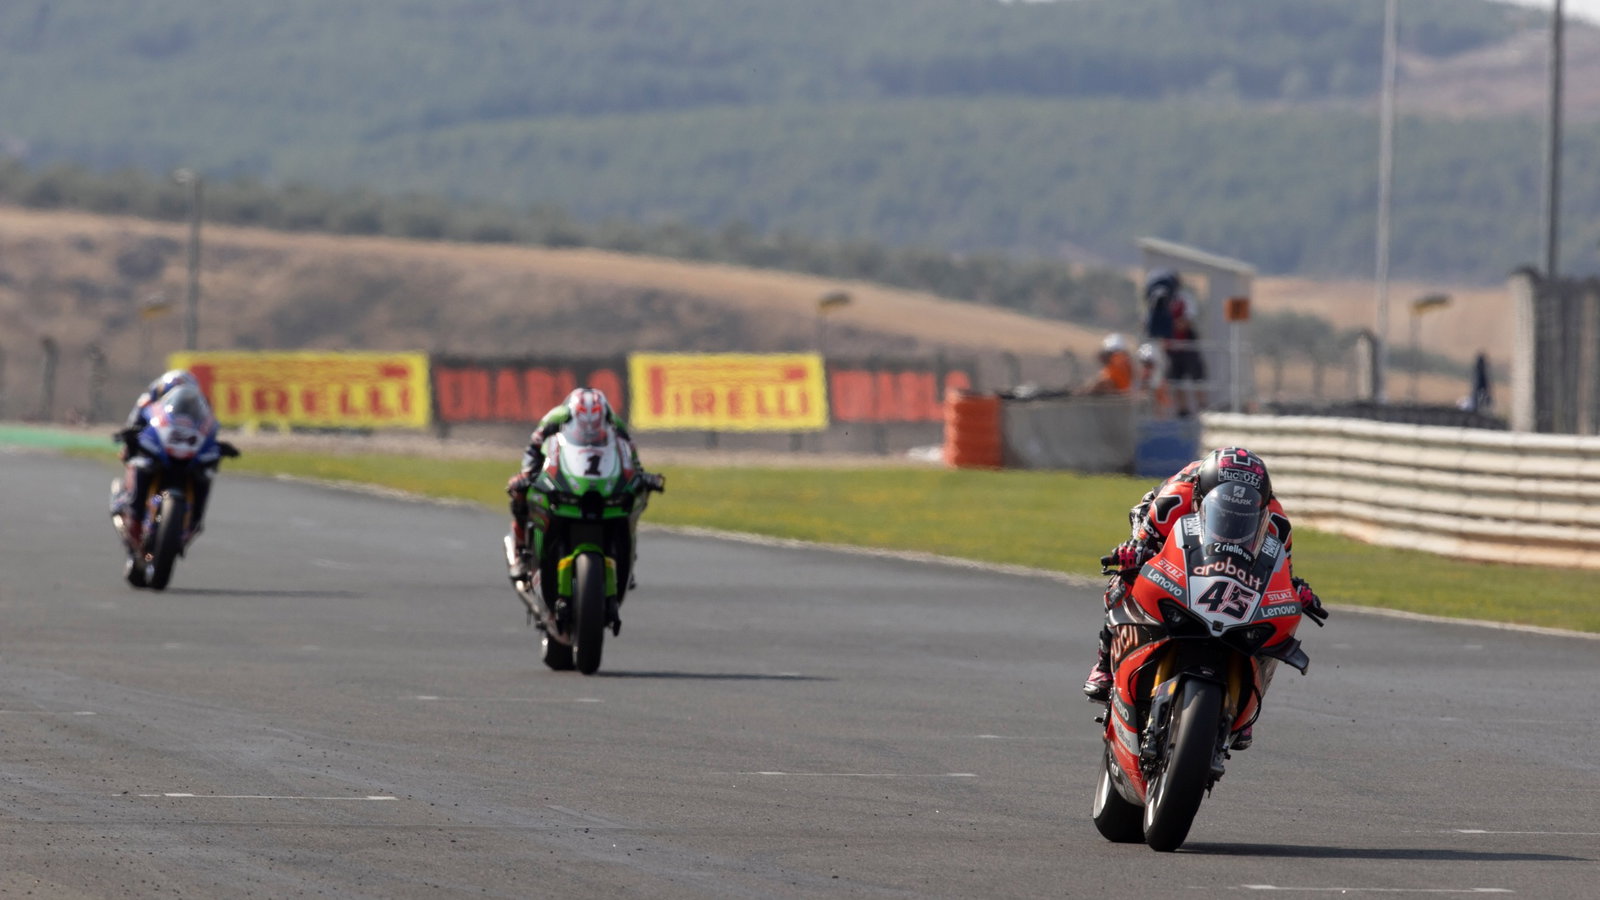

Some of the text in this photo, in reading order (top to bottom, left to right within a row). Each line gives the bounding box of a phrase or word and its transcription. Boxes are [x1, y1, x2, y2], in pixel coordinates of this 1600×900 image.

[650, 361, 808, 419] PIRELLI
[584, 454, 602, 476] 1
[1222, 494, 1252, 505] SHARK
[1222, 542, 1243, 555] riello
[1147, 568, 1183, 597] Lenovo
[1193, 556, 1262, 591] aruba.it
[1196, 580, 1256, 621] 45
[1268, 591, 1293, 602] STULZ
[1260, 605, 1297, 618] Lenovo
